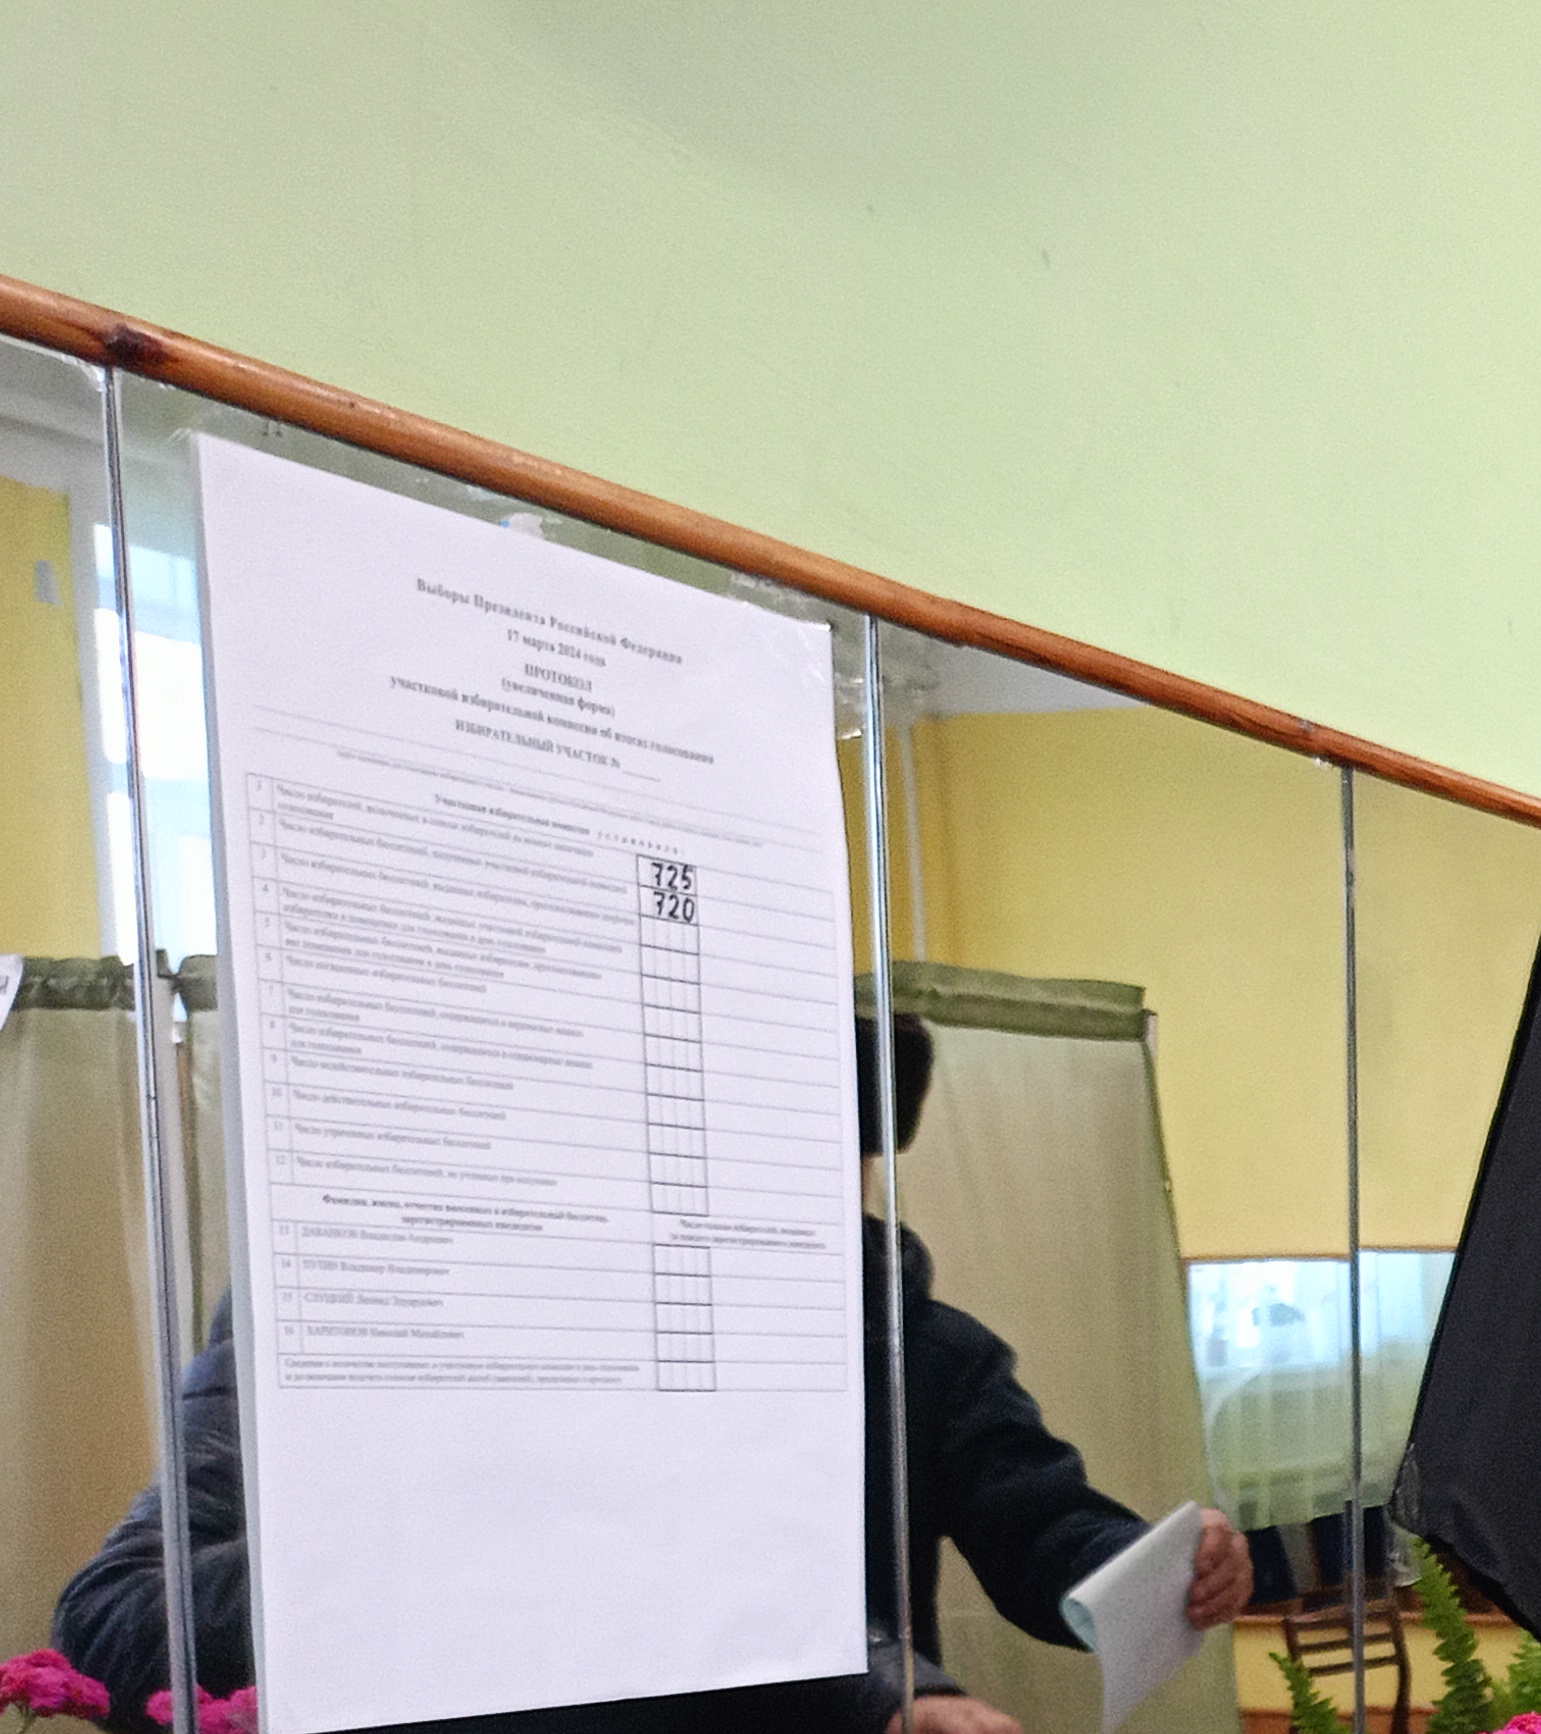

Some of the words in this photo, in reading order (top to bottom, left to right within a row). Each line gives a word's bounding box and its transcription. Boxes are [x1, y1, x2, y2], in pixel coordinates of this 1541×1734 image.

[417, 578, 470, 605] Выборы
[473, 594, 546, 626] Президента
[549, 615, 617, 646] Российской
[557, 642, 582, 661] 2024
[651, 862, 693, 891] 725
[653, 891, 696, 924] 720
